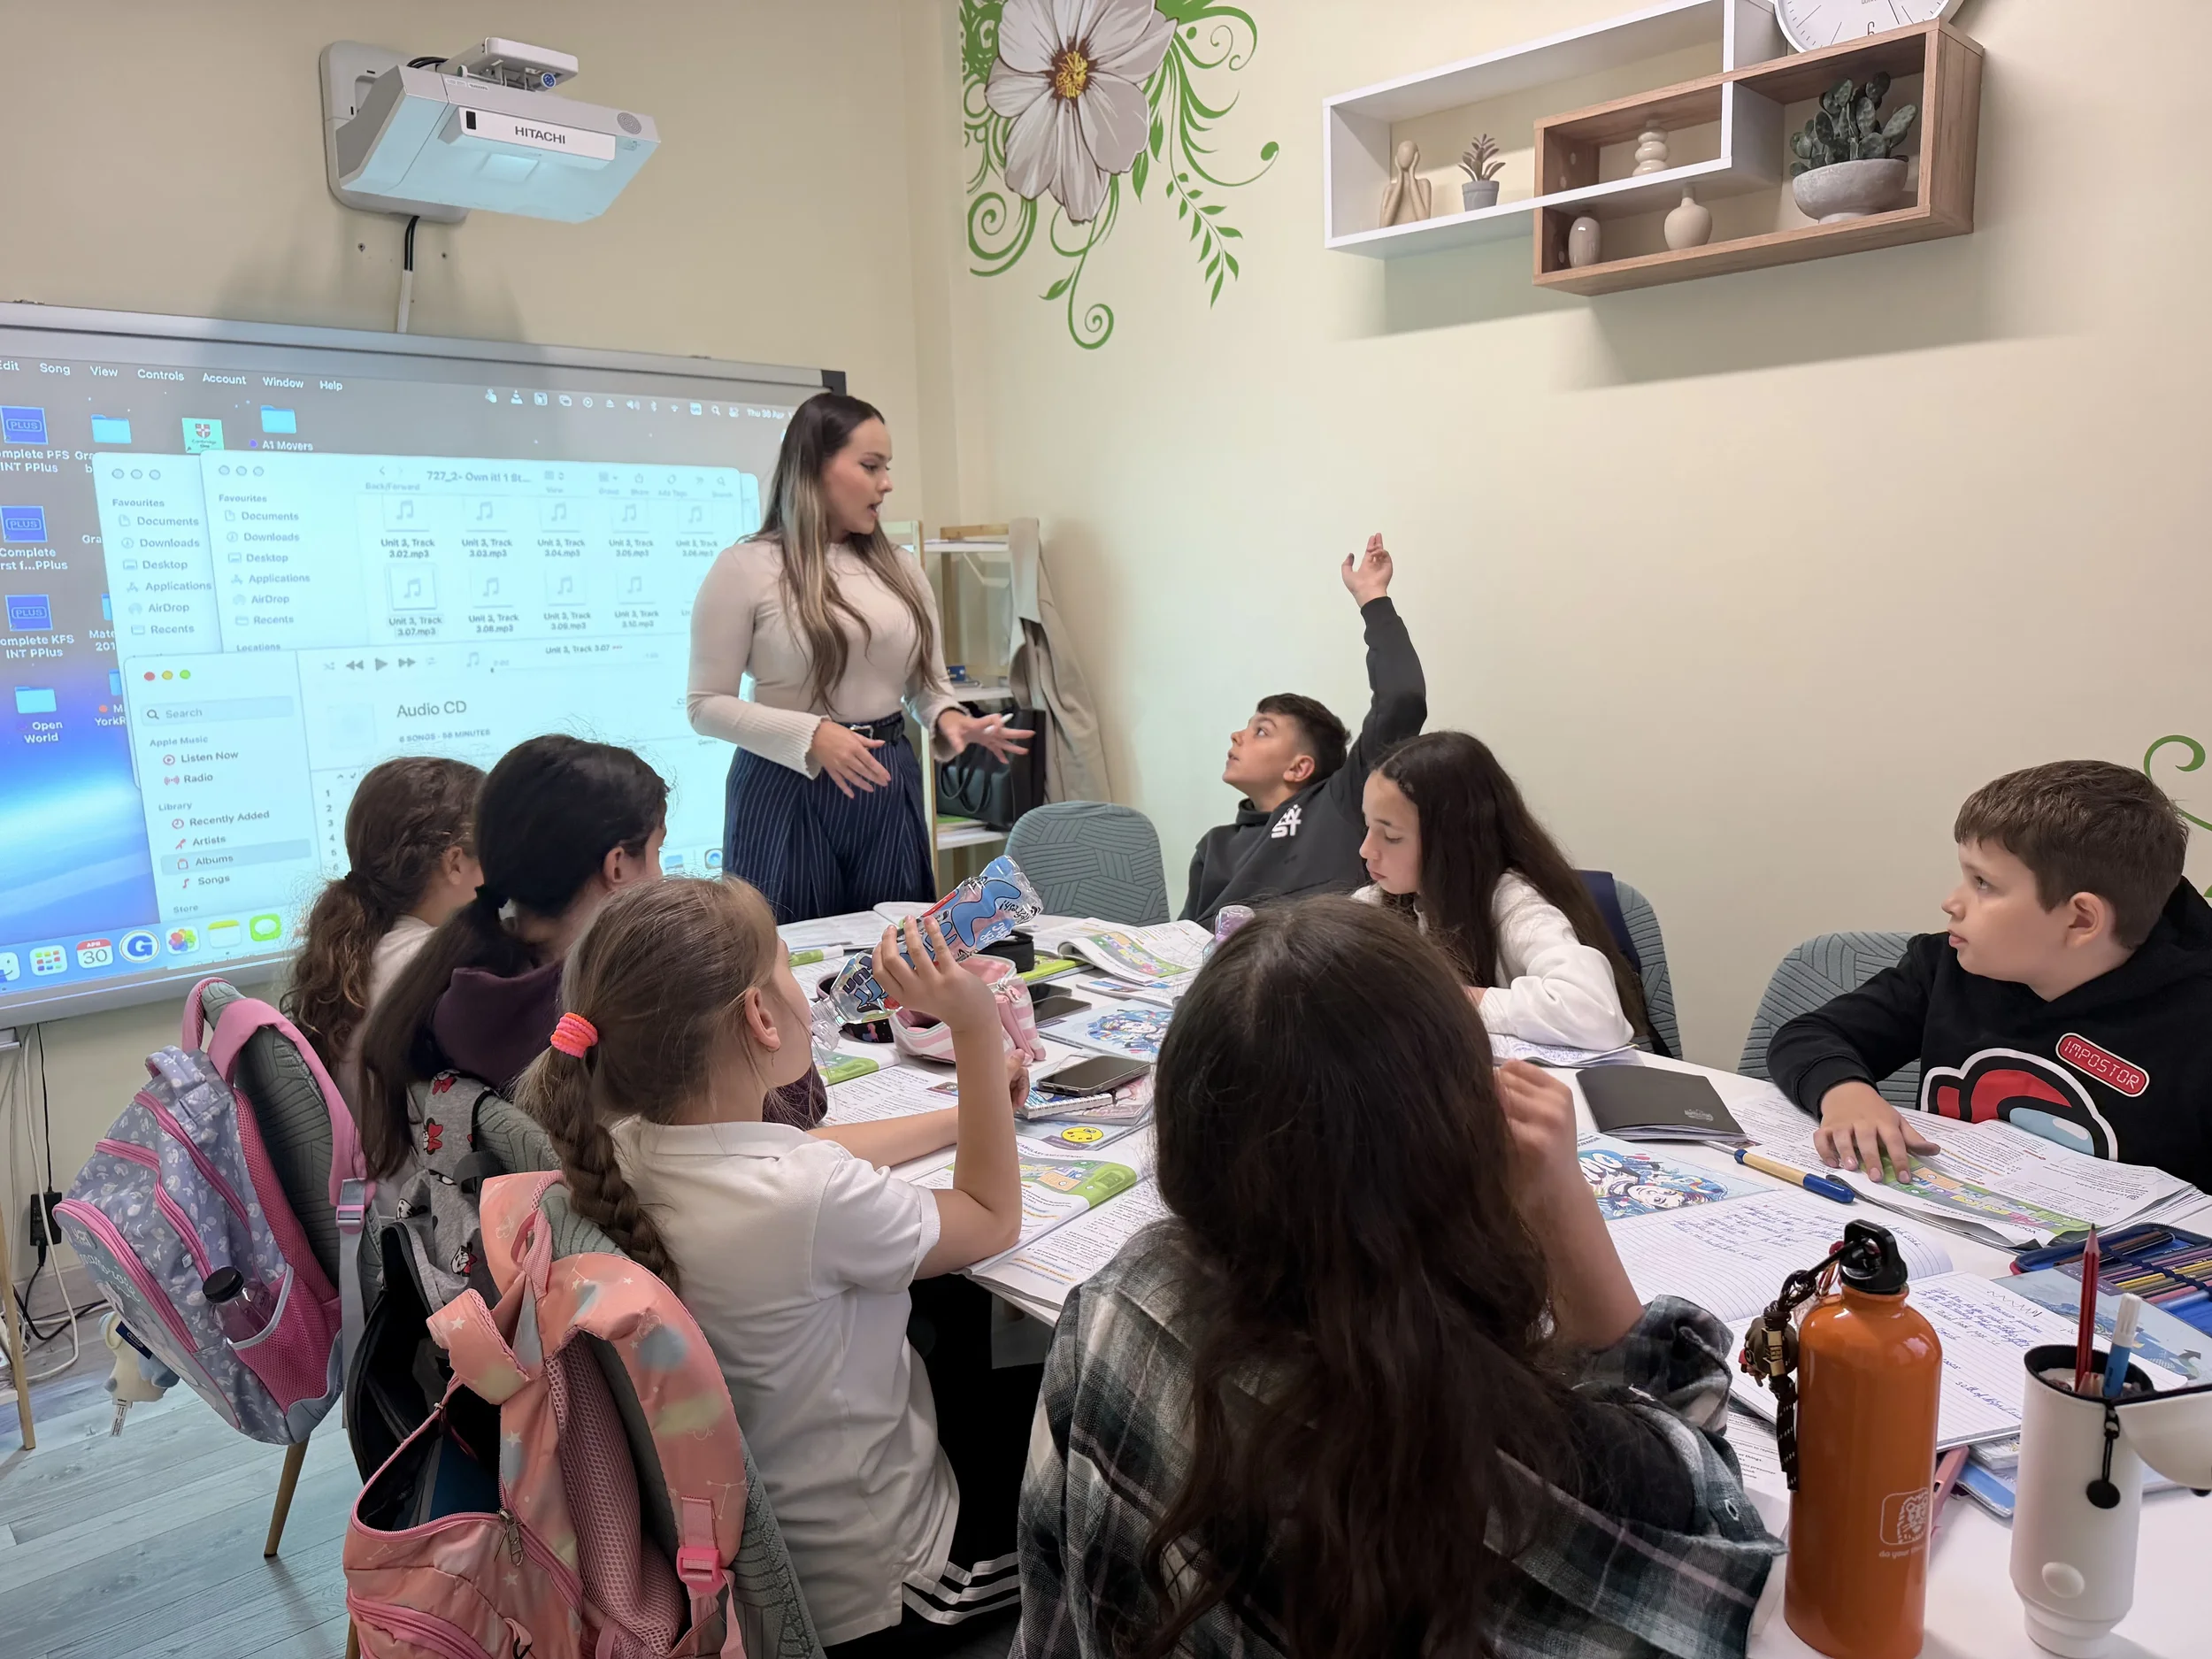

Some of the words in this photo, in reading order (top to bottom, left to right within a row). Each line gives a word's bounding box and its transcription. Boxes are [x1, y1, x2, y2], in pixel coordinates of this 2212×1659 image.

[514, 126, 566, 145] HITACHI
[40, 363, 71, 376] Song
[89, 365, 119, 377] View
[137, 368, 185, 381] Controls
[203, 373, 247, 385] Account
[262, 376, 304, 389] Window
[319, 380, 343, 392] Help
[11, 420, 38, 430] PLUS
[262, 441, 274, 449] A1
[277, 441, 313, 451] Movers
[47, 449, 70, 460] PFS
[0, 462, 21, 472] INT
[465, 472, 488, 481] Own
[112, 498, 165, 508] Favourites
[219, 494, 267, 503] Favourites
[137, 517, 199, 526] Documents
[242, 511, 299, 521] Documents
[10, 519, 38, 529] PLUS
[244, 533, 300, 542] Downloads
[412, 538, 435, 547] Track
[140, 538, 200, 549] Downloads
[0, 548, 57, 559] Complete
[246, 554, 288, 564] Desktop
[142, 560, 188, 571] Desktop
[249, 574, 311, 585] Applications
[145, 581, 212, 594] Applications
[251, 595, 290, 605] AirDrop
[16, 608, 43, 618] PLUS
[149, 603, 189, 614] AirDrop
[253, 615, 295, 625] Recents
[388, 617, 408, 626] Unit
[420, 616, 442, 625] Track
[150, 625, 195, 635] Recents
[51, 634, 74, 645] KFS
[236, 643, 281, 652] Locations
[6, 649, 27, 659] INT
[165, 709, 204, 719] Search
[397, 702, 440, 718] Audio
[443, 701, 467, 715] CD
[32, 721, 63, 733] Open
[24, 733, 59, 744] World
[407, 733, 436, 742] SONGS
[455, 729, 491, 739] MINUTES
[150, 737, 178, 748] Apple
[180, 735, 209, 745] Music
[180, 754, 213, 764] Listen
[215, 751, 239, 761] Now
[183, 772, 213, 783] Radio
[158, 802, 192, 812] Library
[189, 814, 234, 827] Recently
[237, 810, 270, 822] Added
[193, 835, 227, 847] Artists
[196, 855, 234, 866] Albums
[198, 874, 231, 886] Songs
[173, 903, 198, 914] Store
[82, 949, 108, 964] 30
[2064, 1040, 2140, 1090] IMPOSTOR
